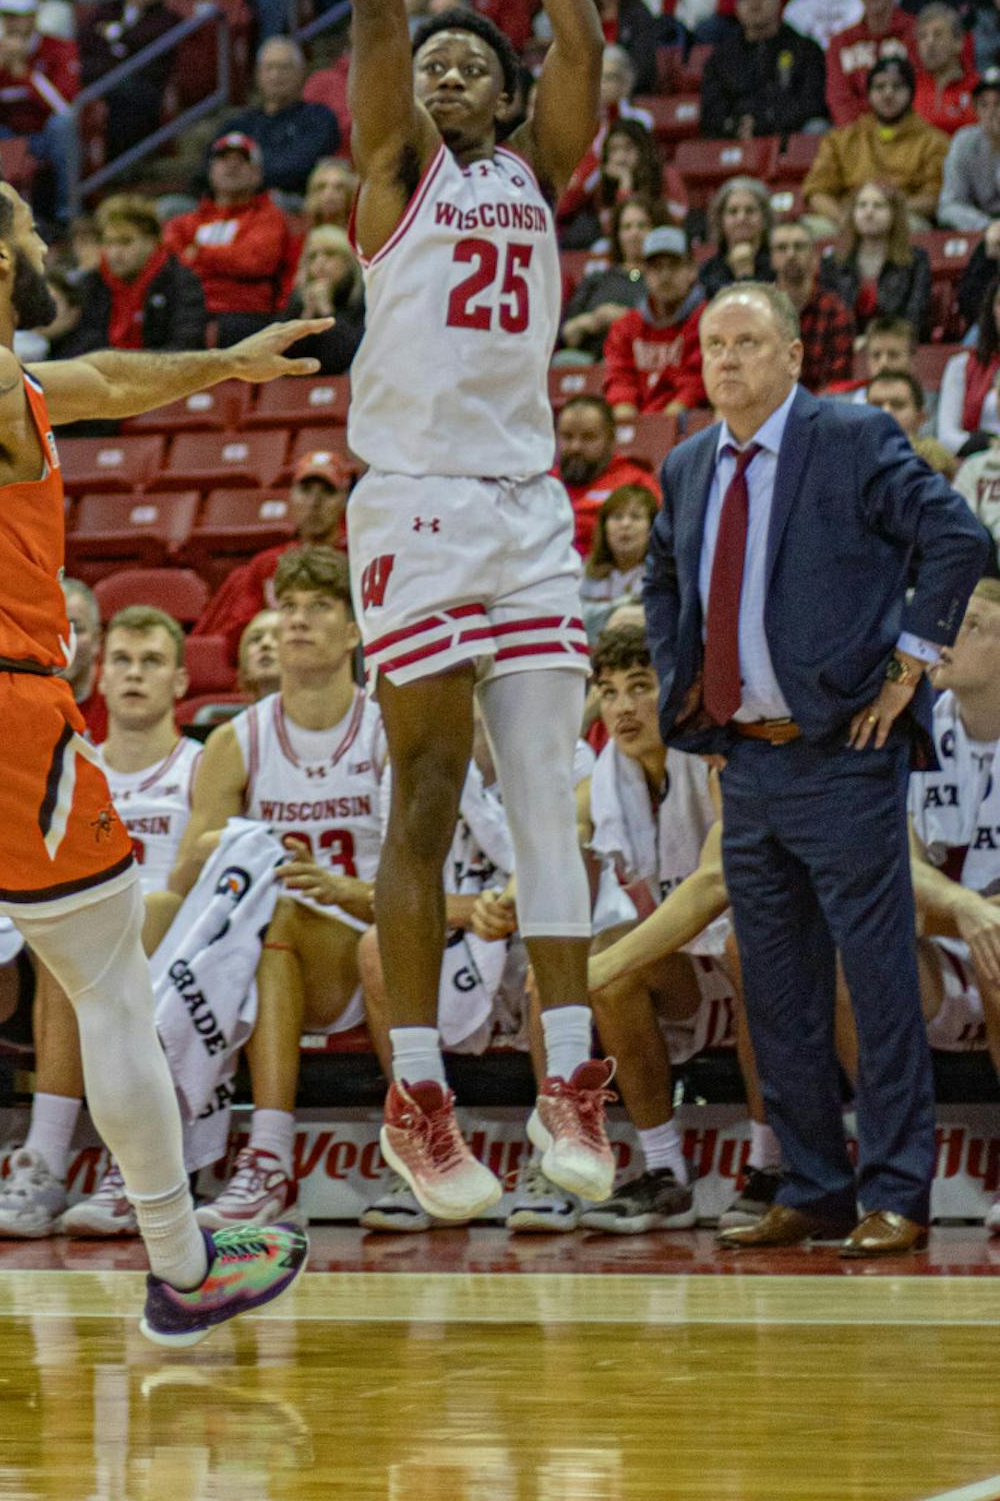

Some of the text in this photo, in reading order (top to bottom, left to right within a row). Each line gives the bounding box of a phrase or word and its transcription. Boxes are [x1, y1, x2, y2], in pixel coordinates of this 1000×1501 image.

[433, 201, 549, 233] WISCONSIN
[446, 237, 534, 335] 25
[259, 795, 373, 822] WISCONSIN
